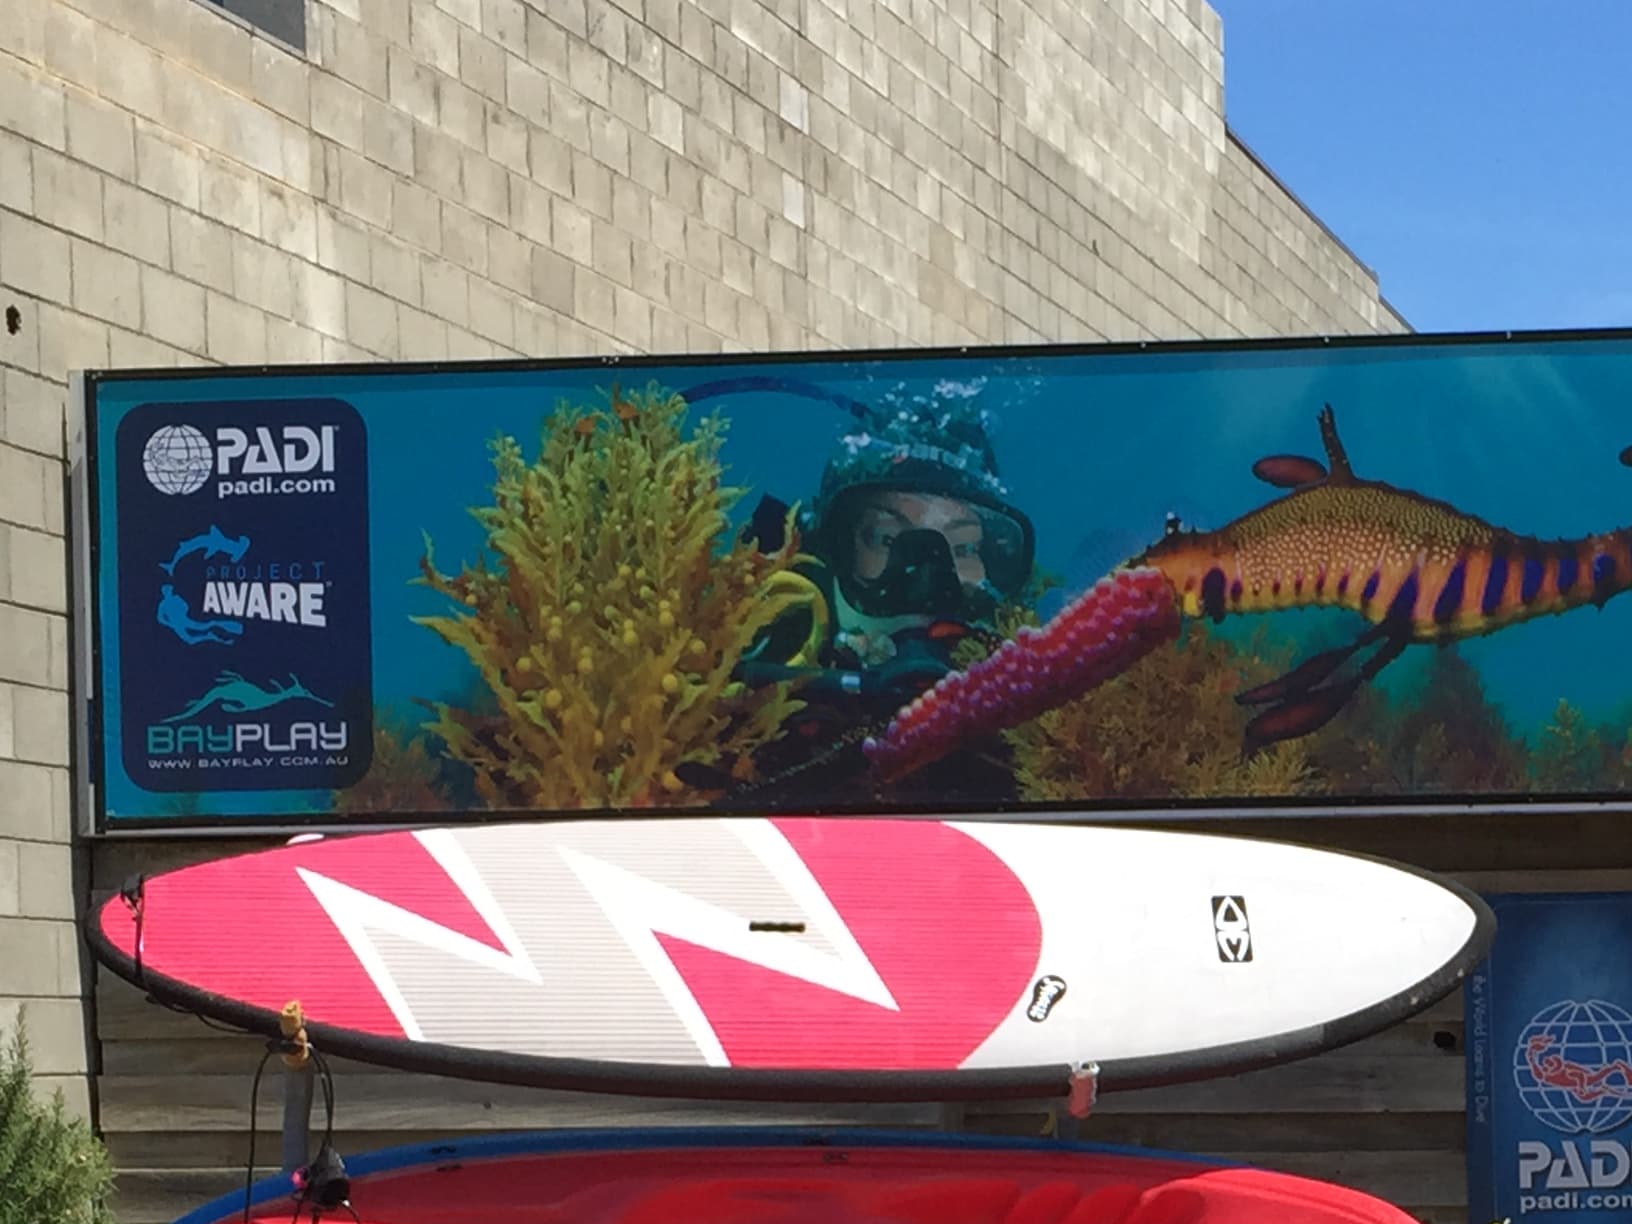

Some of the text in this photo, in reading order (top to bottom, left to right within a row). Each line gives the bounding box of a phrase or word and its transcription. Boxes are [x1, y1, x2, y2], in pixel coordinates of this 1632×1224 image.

[217, 425, 336, 475] PADI
[218, 477, 336, 499] padi.com
[206, 562, 325, 580] PROJECT
[203, 581, 328, 628] AWARE
[147, 721, 348, 756] BAYPLAY
